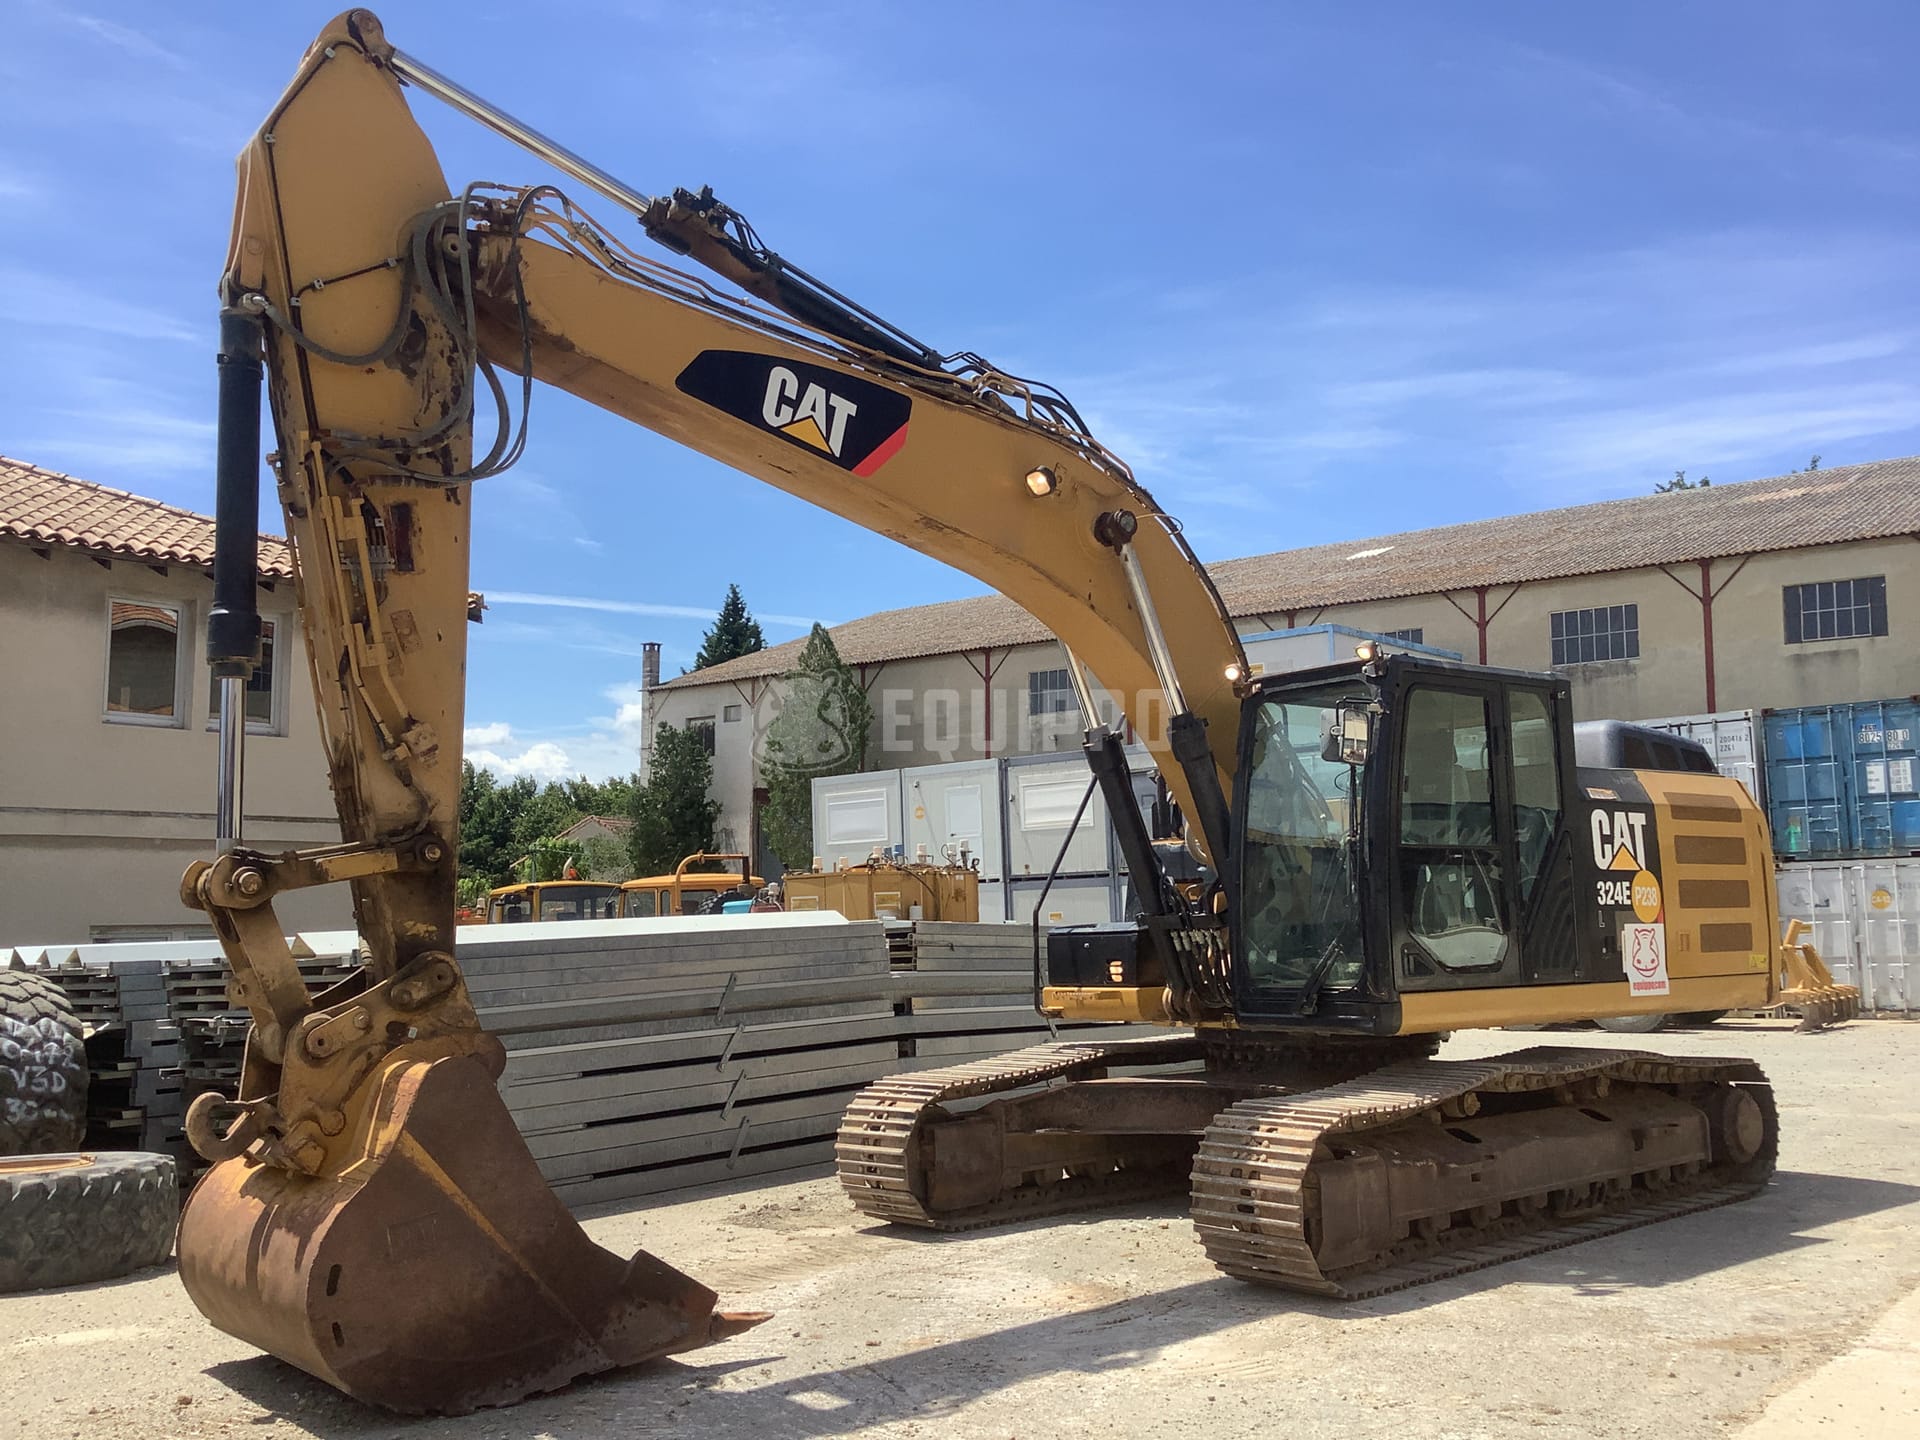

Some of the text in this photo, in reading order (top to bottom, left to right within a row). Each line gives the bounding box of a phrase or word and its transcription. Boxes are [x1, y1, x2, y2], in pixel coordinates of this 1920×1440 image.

[762, 366, 857, 458] CAT
[1591, 808, 1646, 871] CAT
[1597, 881, 1631, 906] 324E
[1635, 886, 1657, 907] P238
